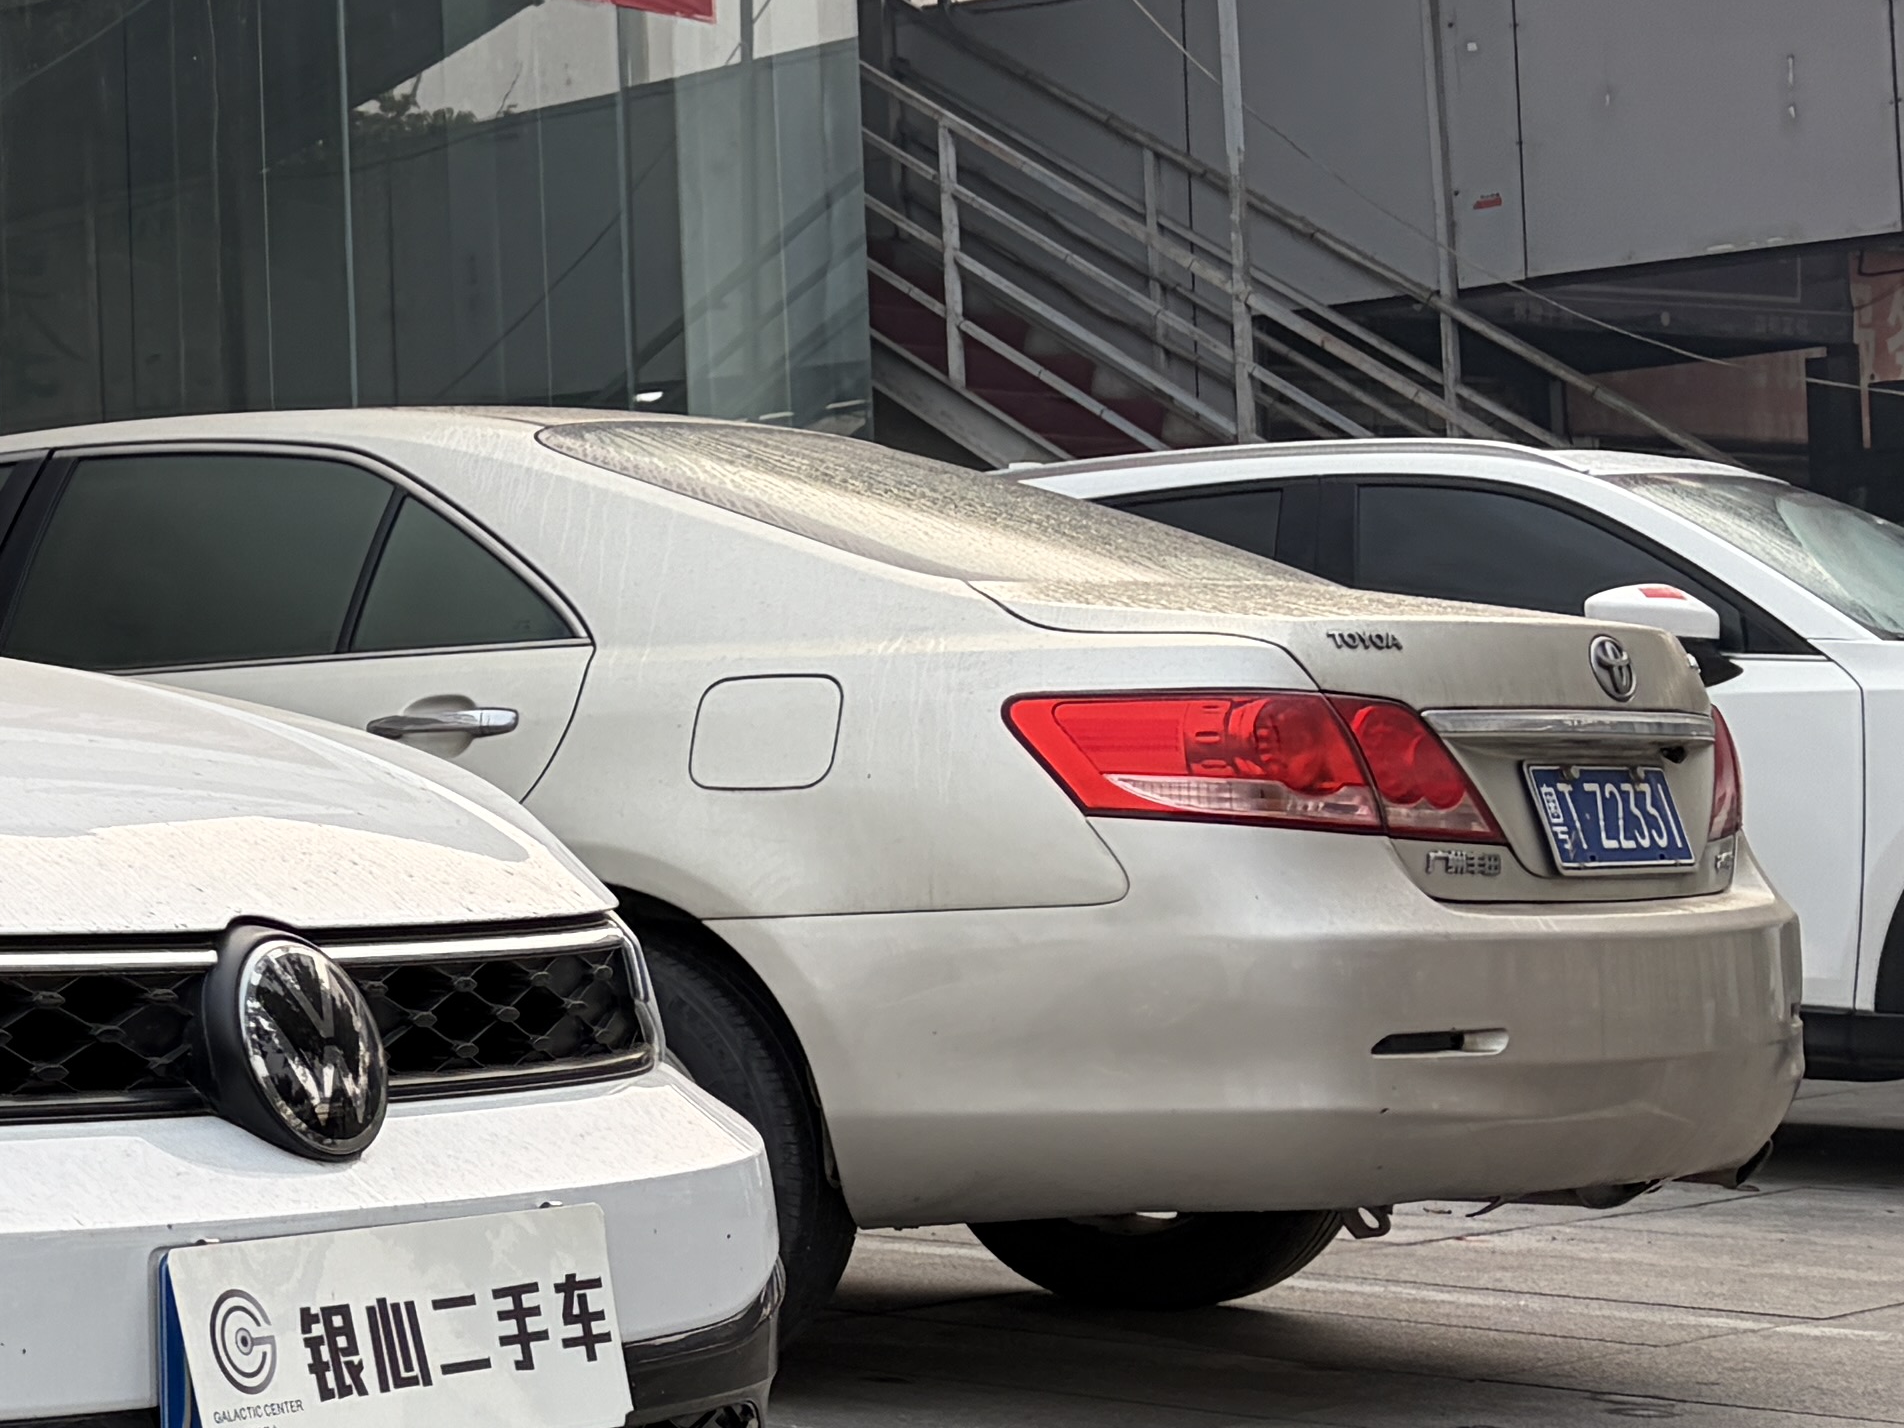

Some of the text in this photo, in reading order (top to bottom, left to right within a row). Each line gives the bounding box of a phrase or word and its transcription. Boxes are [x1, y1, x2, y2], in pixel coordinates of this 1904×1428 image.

[299, 1272, 612, 1403] 银心二手车
[213, 1399, 305, 1425] GALACTIC CENTER
